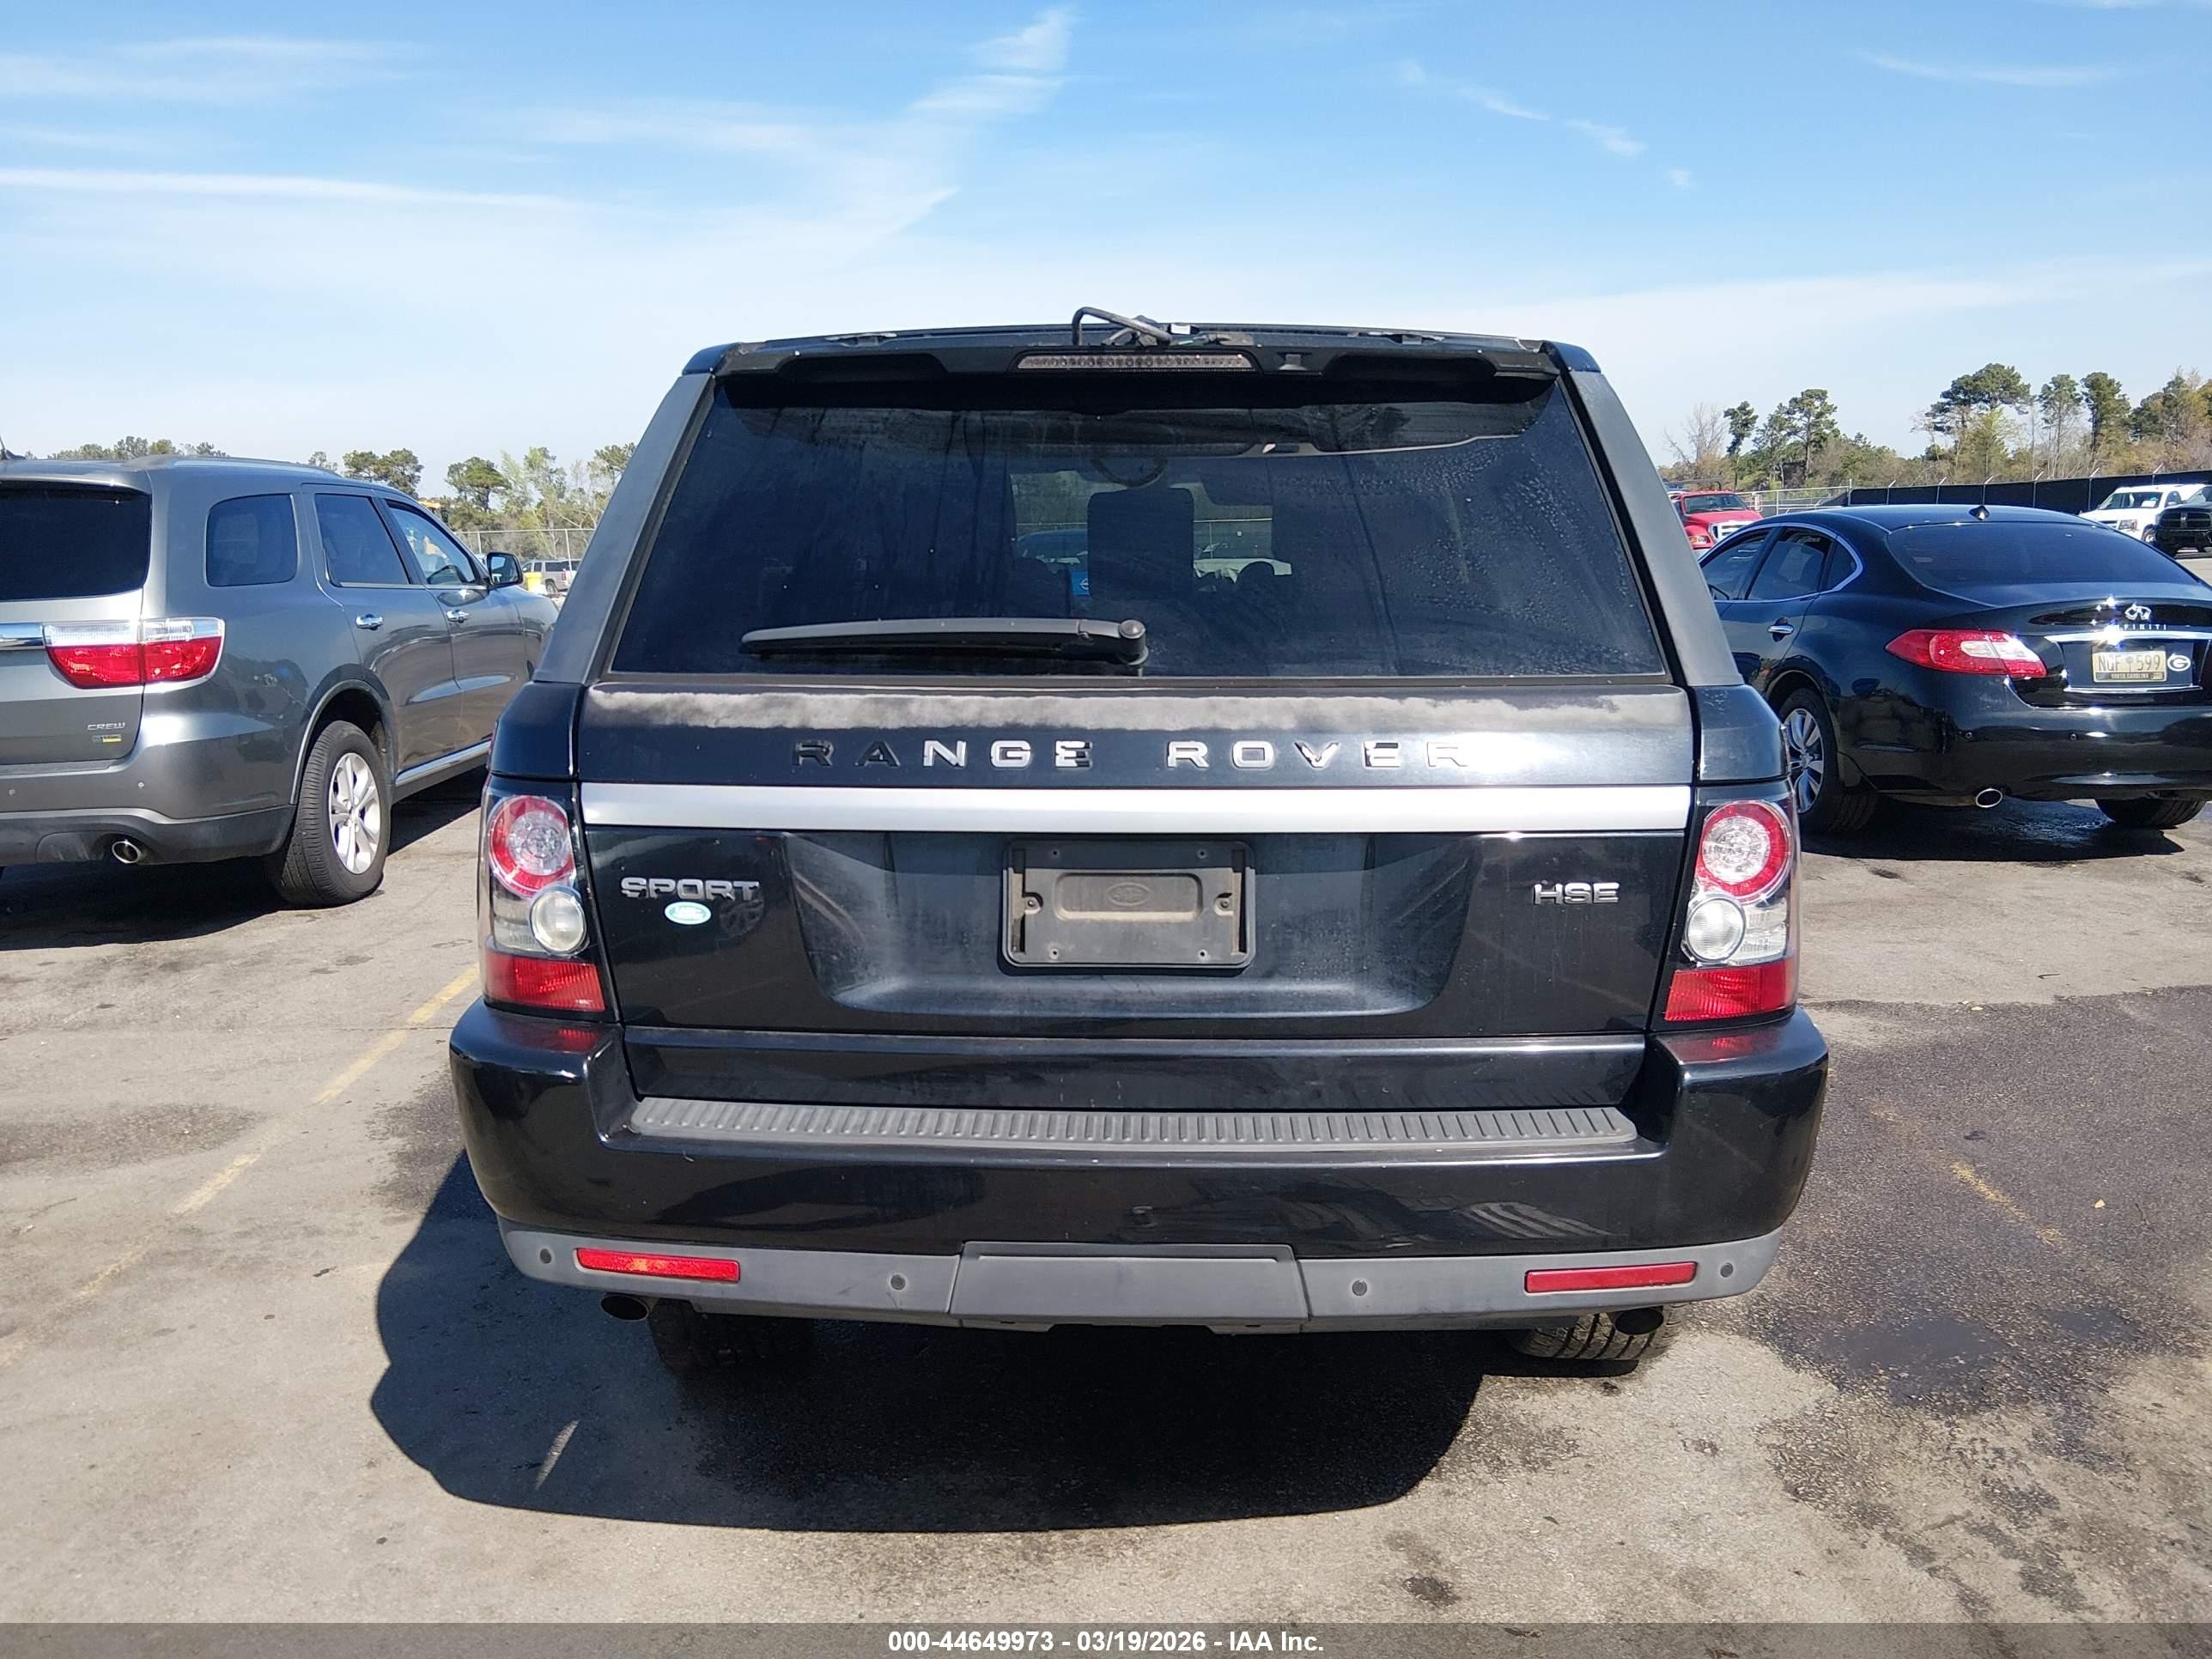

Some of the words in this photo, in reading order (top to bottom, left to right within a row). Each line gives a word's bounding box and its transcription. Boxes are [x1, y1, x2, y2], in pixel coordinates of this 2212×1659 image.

[2136, 654, 2161, 672] 599
[793, 739, 1093, 769] RANGE
[1167, 739, 1469, 769] ROVER
[620, 876, 760, 902] SPORT
[1532, 881, 1620, 905] HSE
